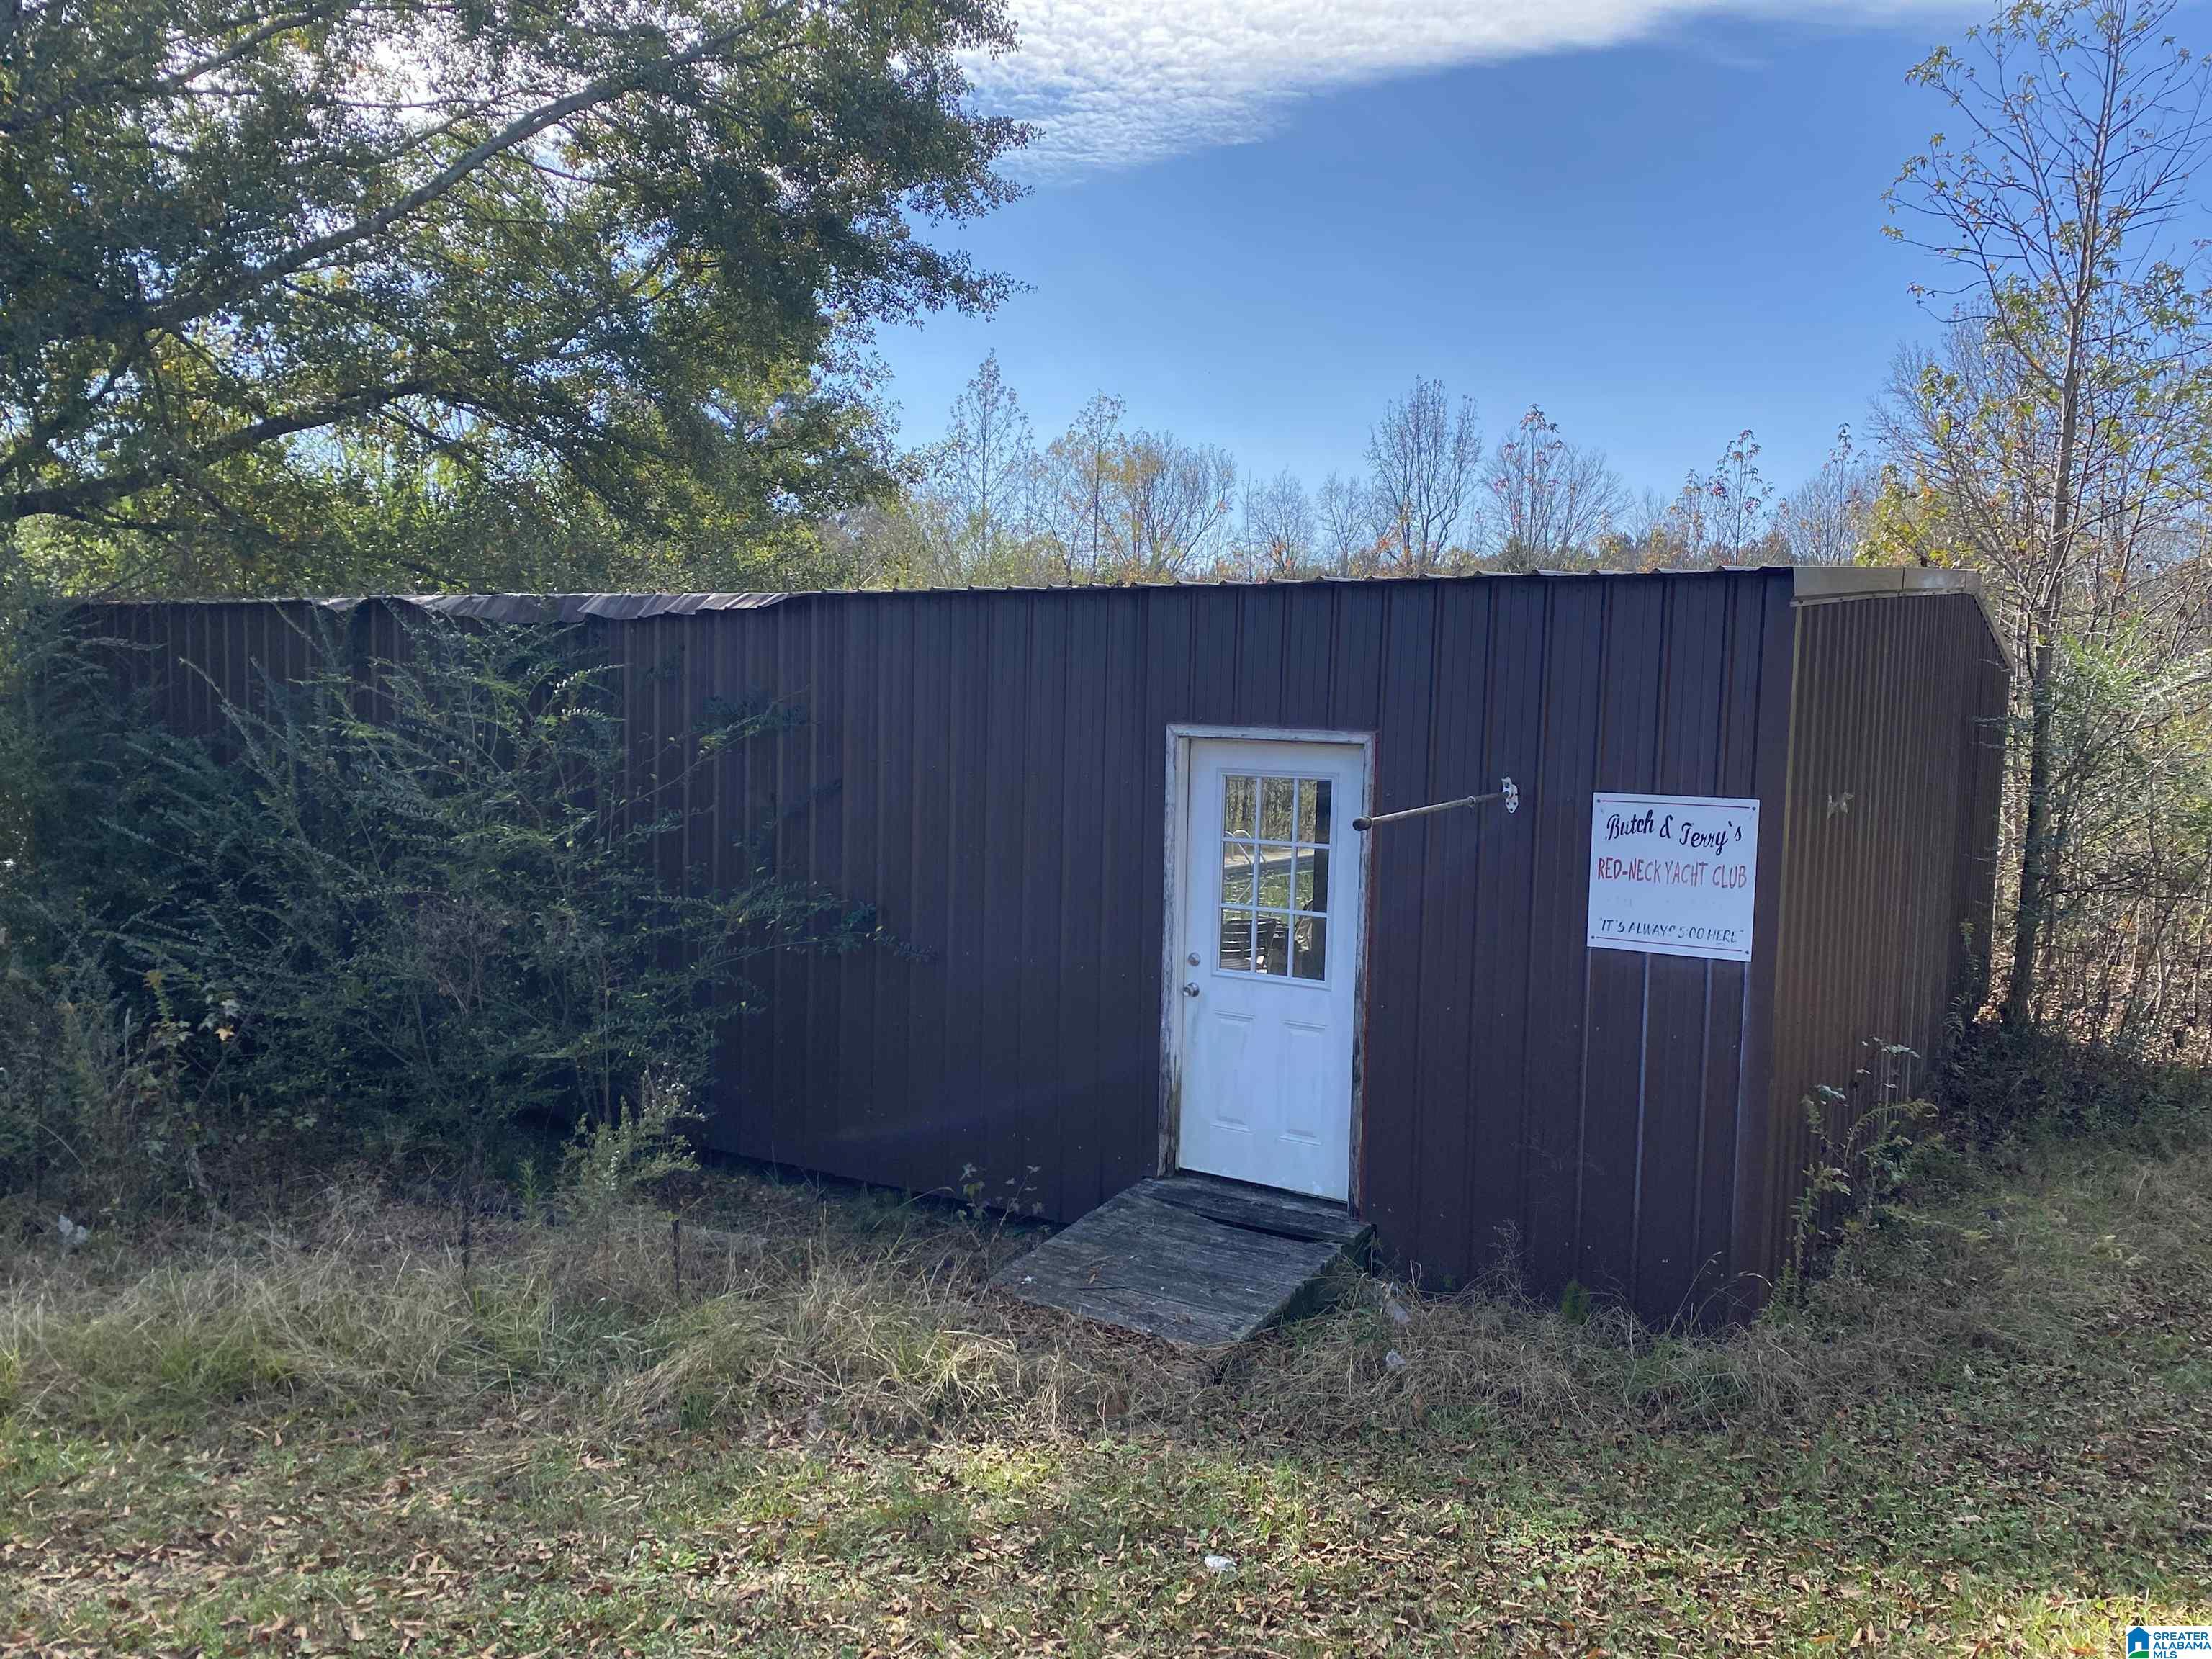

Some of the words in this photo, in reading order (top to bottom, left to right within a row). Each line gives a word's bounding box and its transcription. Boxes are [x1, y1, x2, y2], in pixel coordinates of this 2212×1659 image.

[1606, 809, 1655, 841] Butch
[1659, 814, 1674, 839] &
[1597, 857, 1661, 884] RED-NECK
[1665, 860, 1709, 887] YACHT
[1712, 864, 1748, 889] CLUB
